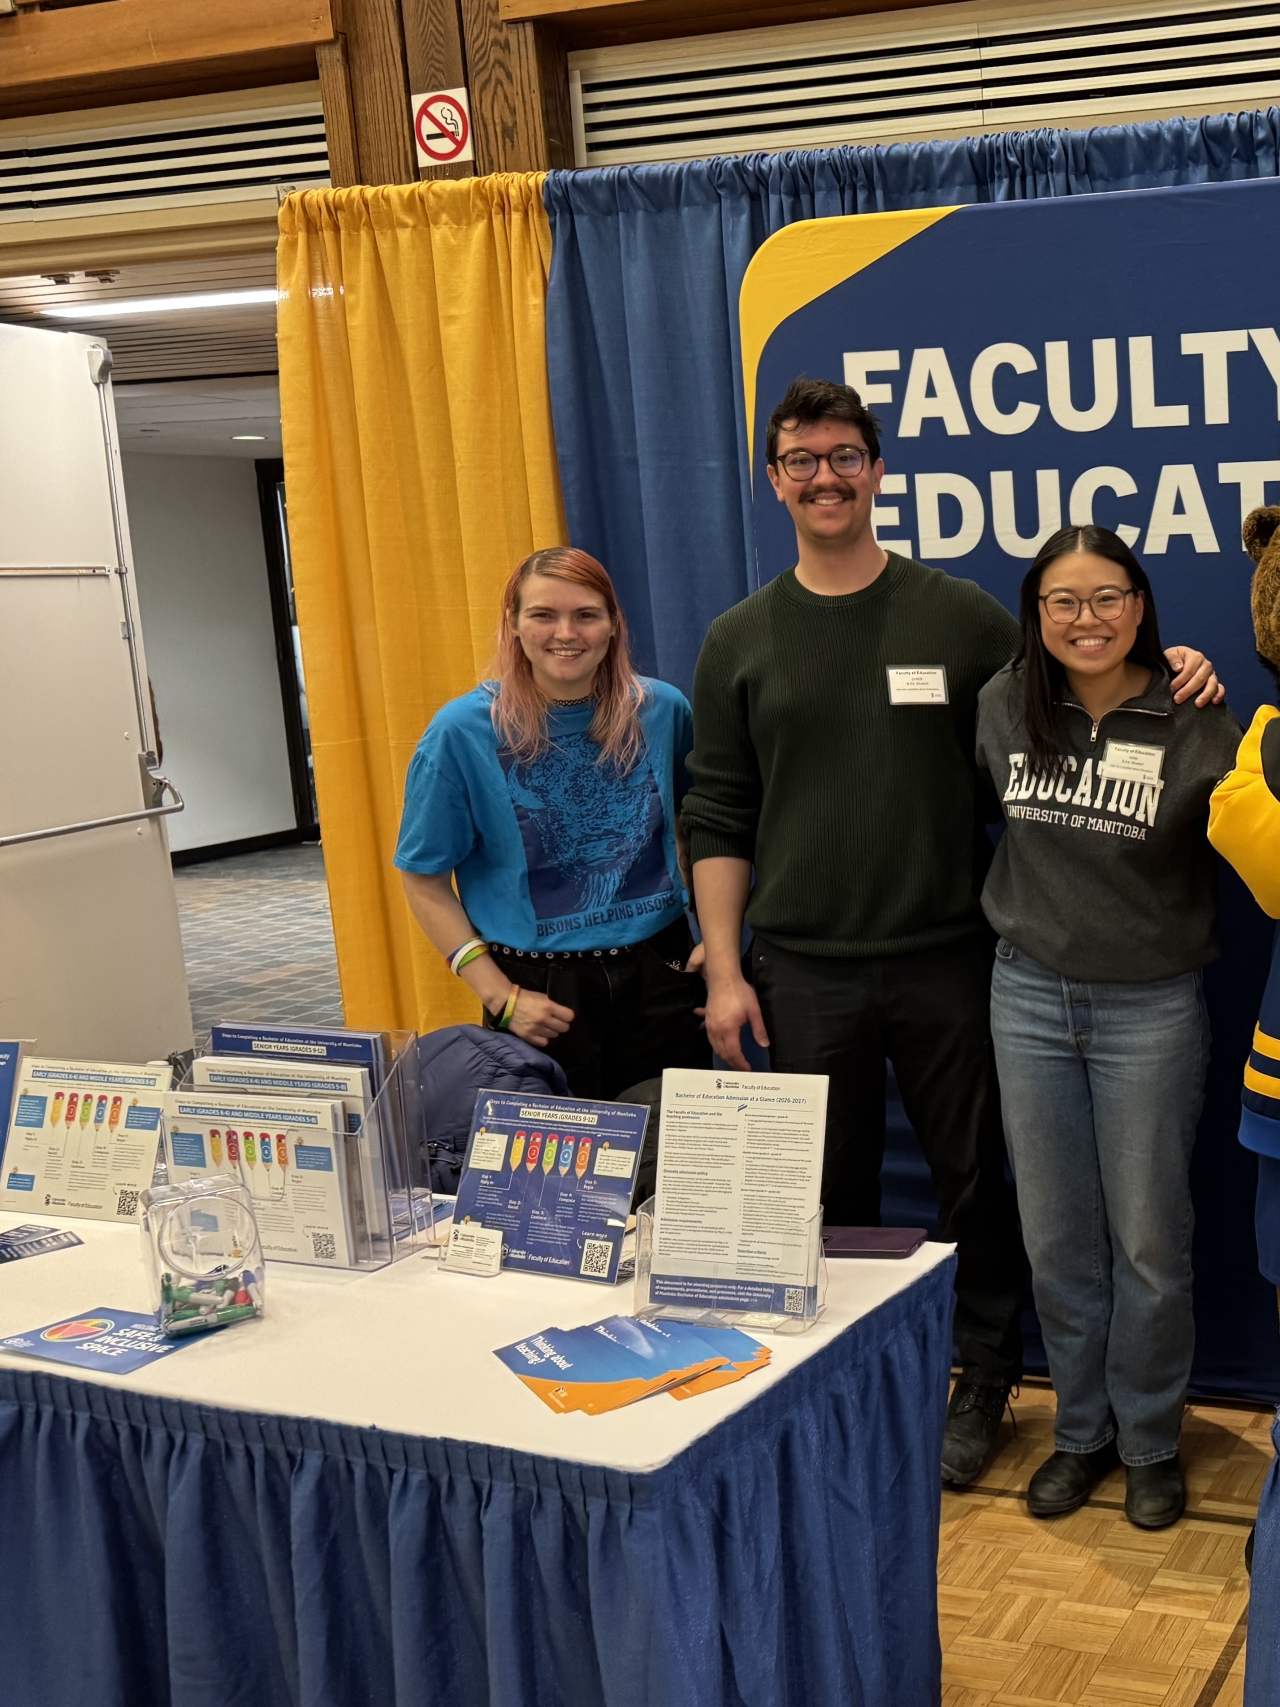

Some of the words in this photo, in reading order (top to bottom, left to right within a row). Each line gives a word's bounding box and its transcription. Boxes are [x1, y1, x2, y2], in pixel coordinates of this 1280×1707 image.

[1003, 752, 1165, 828] EDUCATION
[1007, 804, 1069, 825] UNIVERSITY
[1070, 814, 1085, 828] OF
[1087, 816, 1147, 840] MANITOBA
[537, 917, 581, 937] BISONS
[584, 905, 634, 927] HELPING
[558, 1113, 582, 1121] (GRADES
[582, 1115, 595, 1123] 9-12)
[94, 1336, 175, 1353] INCLUSIVE
[112, 1329, 156, 1339] SAFE
[75, 1343, 128, 1356] SPACE
[531, 1336, 556, 1358] Thinking
[551, 1354, 573, 1370] about
